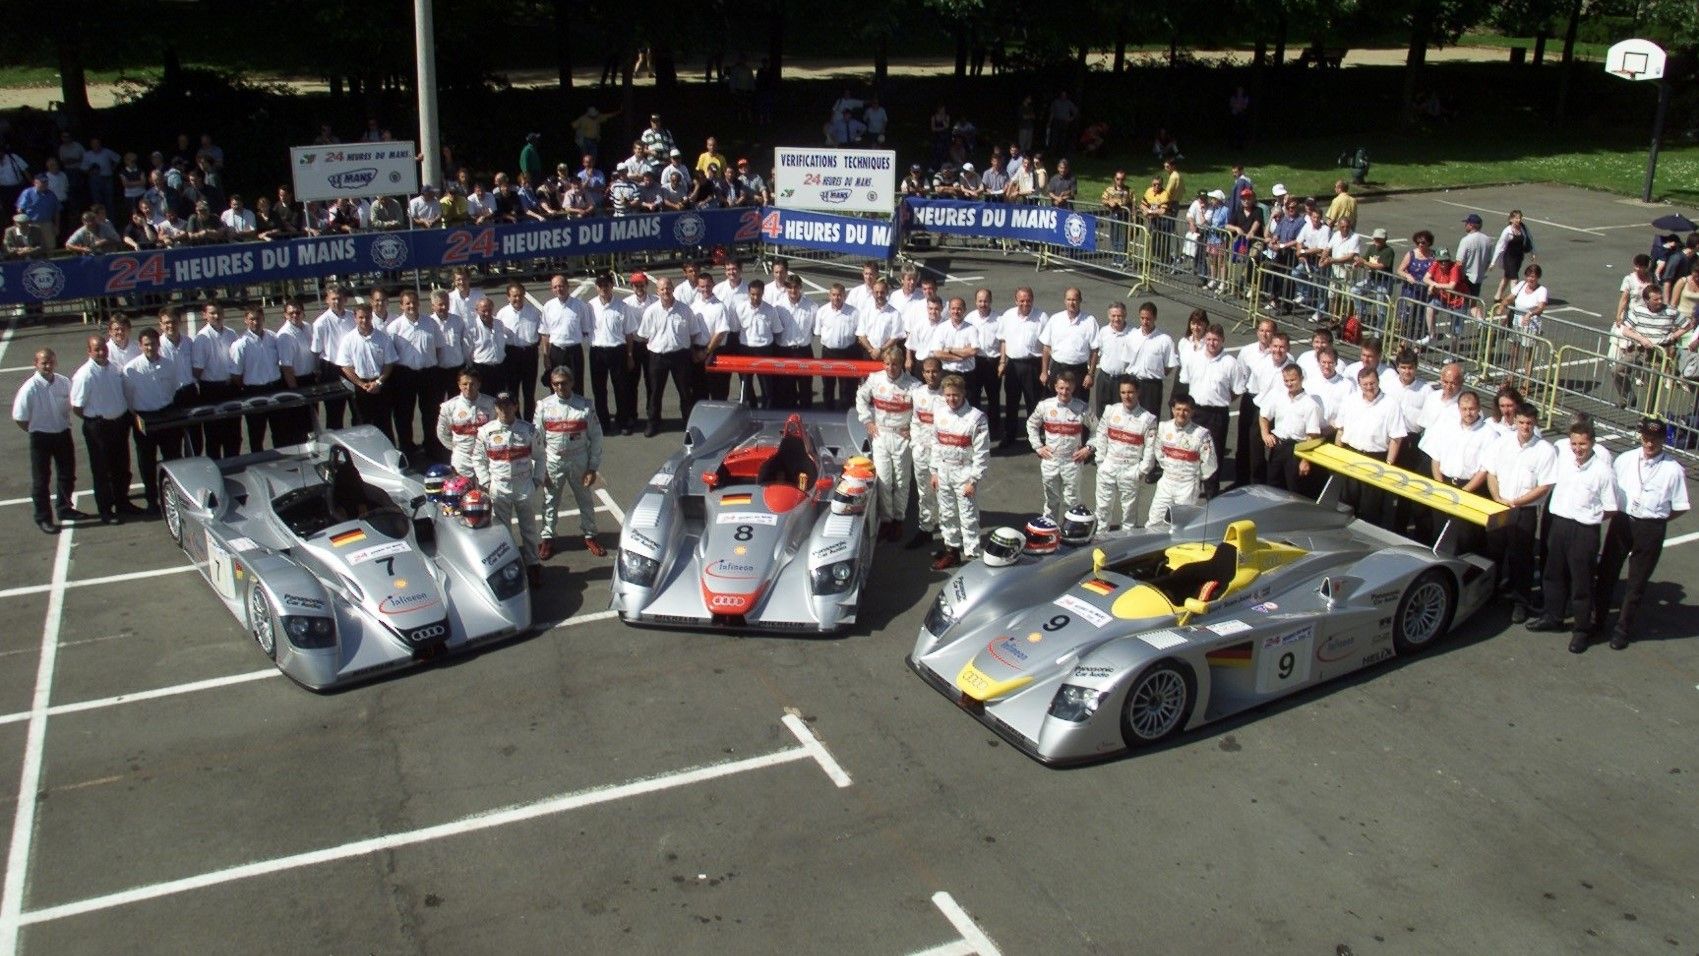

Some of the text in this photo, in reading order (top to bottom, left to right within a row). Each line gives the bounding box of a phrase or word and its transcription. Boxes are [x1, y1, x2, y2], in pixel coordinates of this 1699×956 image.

[325, 151, 345, 162] 24
[375, 151, 385, 160] DU
[389, 150, 409, 159] MANS
[780, 154, 890, 170] VERIFICATIONS TECHNIQUES
[343, 172, 373, 183] MANS
[804, 173, 821, 186] 24
[822, 176, 842, 186] HEURES
[844, 176, 853, 186] DU
[830, 191, 848, 199] MANS
[734, 210, 783, 242] 24
[785, 219, 841, 243] HEURES
[845, 223, 868, 245] DU
[914, 206, 976, 227] HEURES
[981, 208, 1006, 228] DU
[1010, 209, 1058, 230] MANS
[441, 227, 499, 264] 24
[503, 227, 571, 255] HEURES
[579, 223, 604, 245] DU
[610, 216, 661, 241] MANS
[105, 253, 170, 293] 24
[175, 251, 254, 283] HEURES
[262, 246, 290, 271] DU
[298, 238, 356, 266] MANS
[733, 525, 754, 541] 8
[215, 560, 220, 581] 7
[375, 556, 395, 576] 7
[1042, 614, 1071, 632] 9
[1278, 652, 1295, 680] 9
